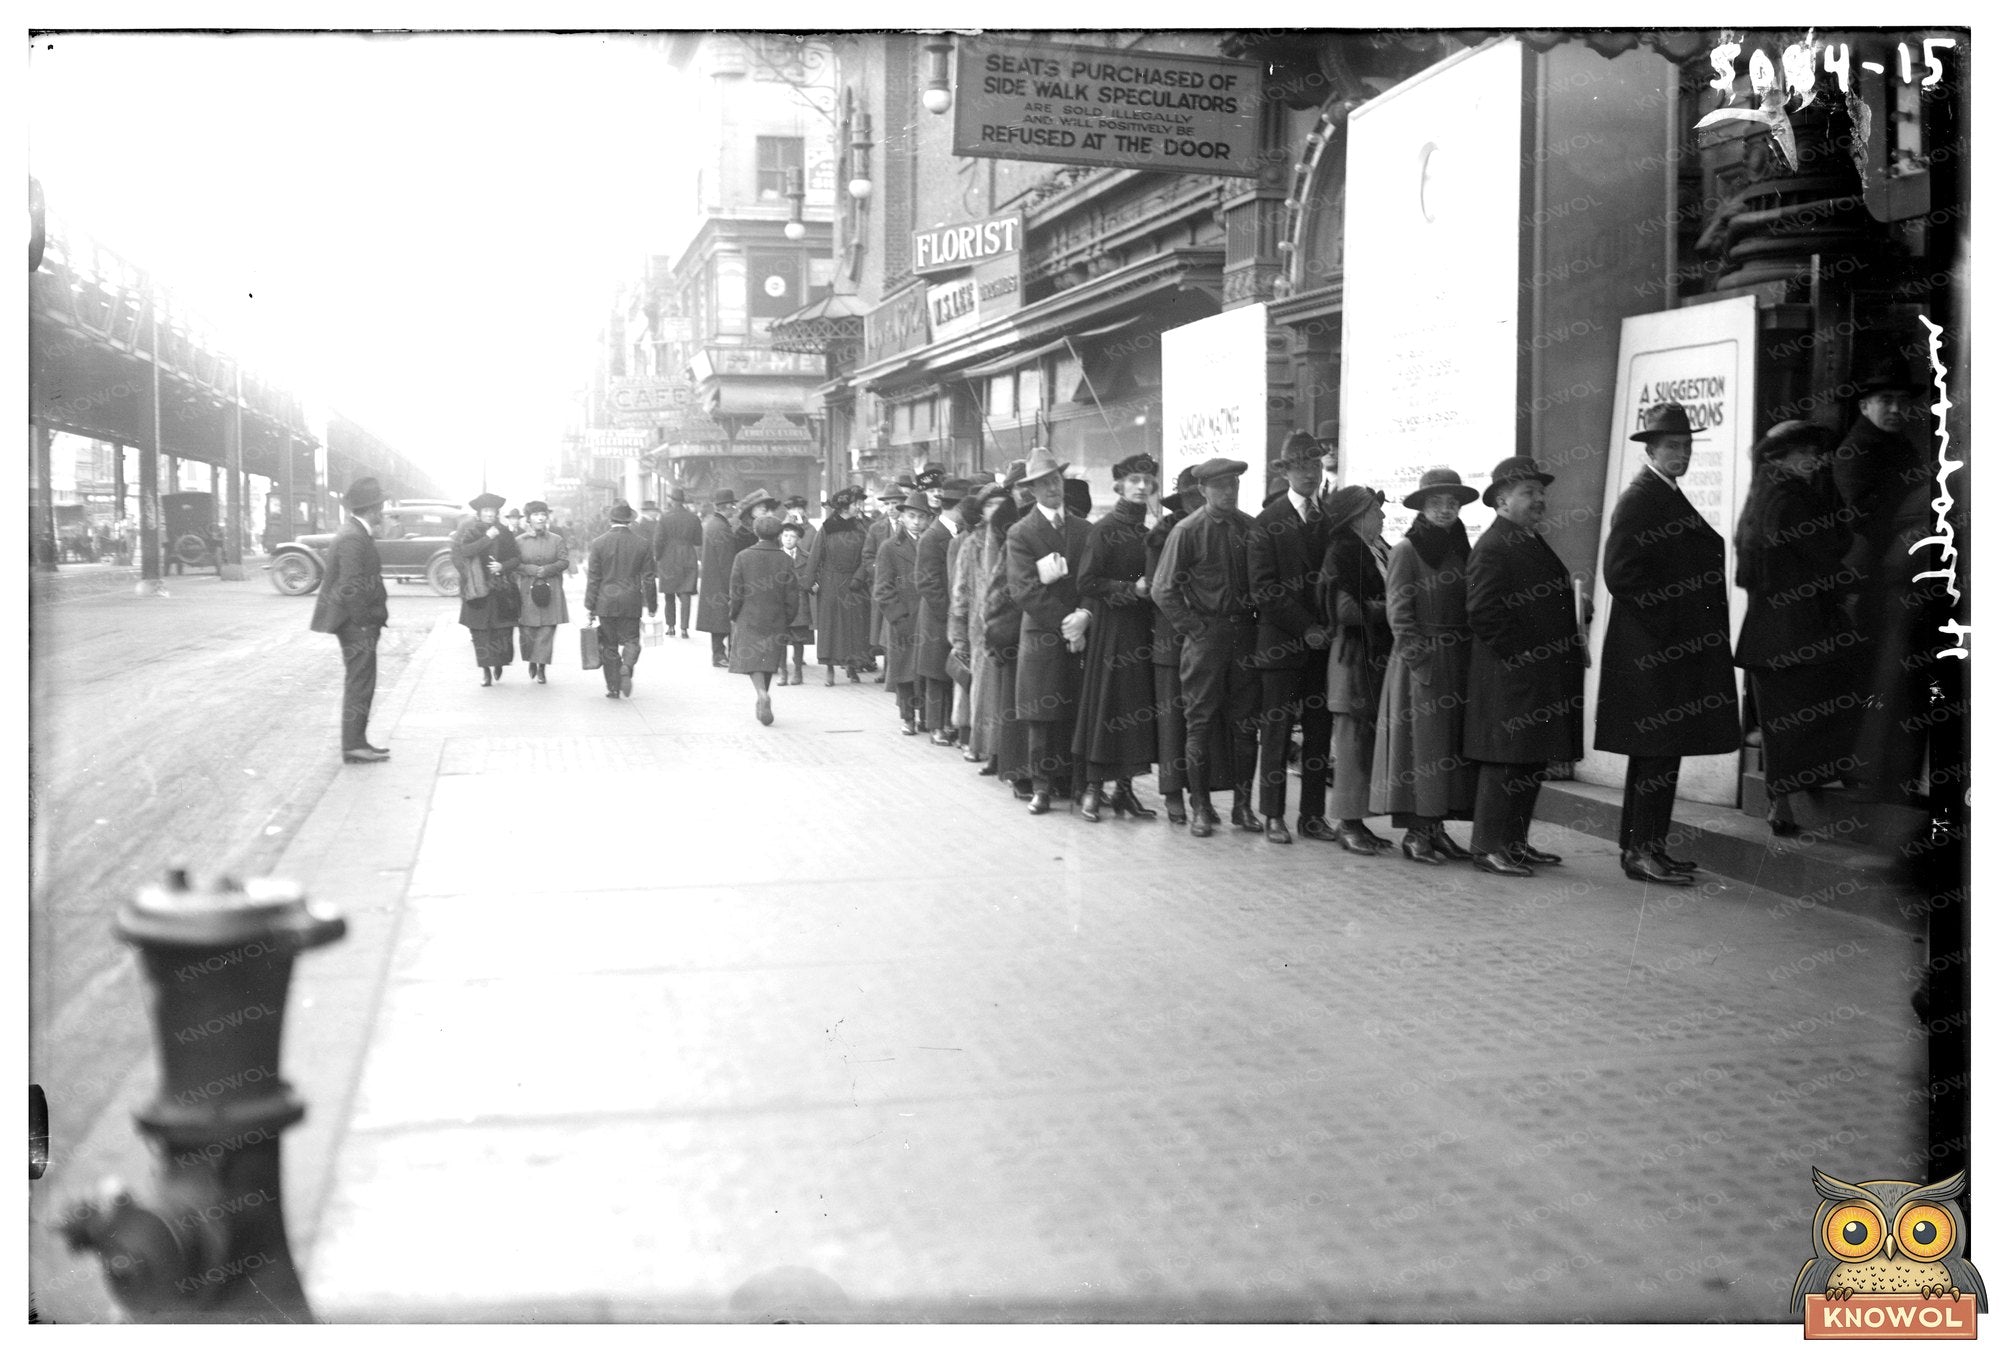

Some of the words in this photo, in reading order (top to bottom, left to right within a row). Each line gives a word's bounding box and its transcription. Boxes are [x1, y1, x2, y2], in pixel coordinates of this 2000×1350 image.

[985, 53, 1061, 78] SEATS
[1071, 60, 1204, 89] PURCHASED
[1208, 74, 1238, 91] OF
[983, 76, 1027, 96] SIDE
[1034, 80, 1089, 101] WALK
[1098, 86, 1238, 113] SPECULATORS
[1022, 114, 1052, 126] AND
[1059, 116, 1093, 128] WILL
[1099, 119, 1173, 135] POSITIVELY
[1176, 124, 1196, 136] BE
[1023, 102, 1052, 113] ARE
[1062, 105, 1102, 117] SOLD
[1110, 109, 1193, 124] ILLEGALLY
[981, 124, 1076, 148] REFUSED
[1081, 132, 1106, 150] AT
[1114, 135, 1153, 153] THE
[1164, 139, 1231, 160] DOOR
[916, 217, 1019, 267] FLORIST
[615, 386, 688, 408] CAFE
[1639, 382, 1650, 404] A
[1653, 376, 1725, 403] SUGGESTION
